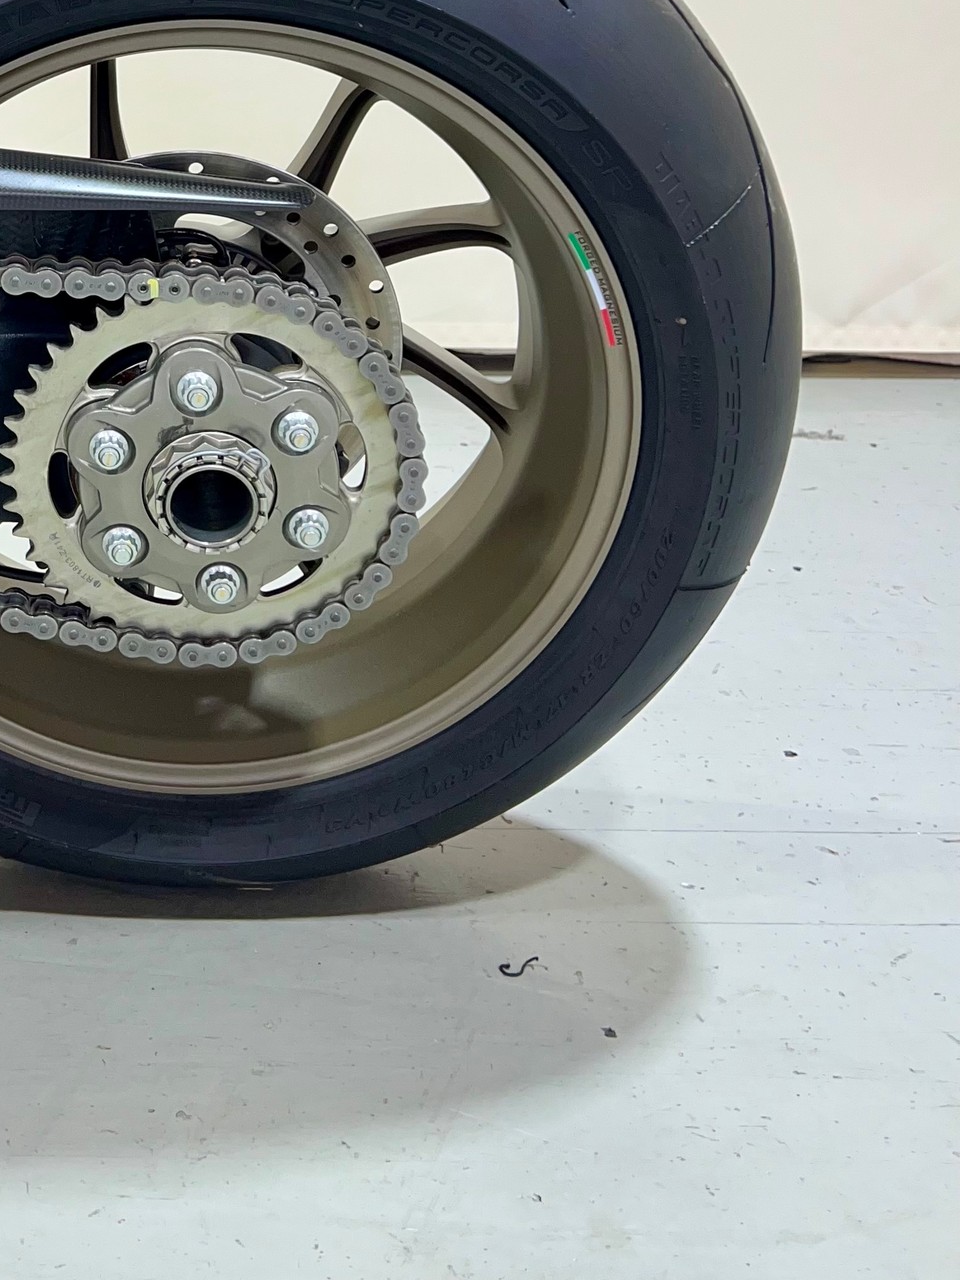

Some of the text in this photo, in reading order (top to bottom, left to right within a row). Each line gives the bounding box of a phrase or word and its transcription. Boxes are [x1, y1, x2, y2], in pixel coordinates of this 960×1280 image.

[582, 140, 633, 194] SP
[574, 230, 624, 346] FORGED MAGNESIUM
